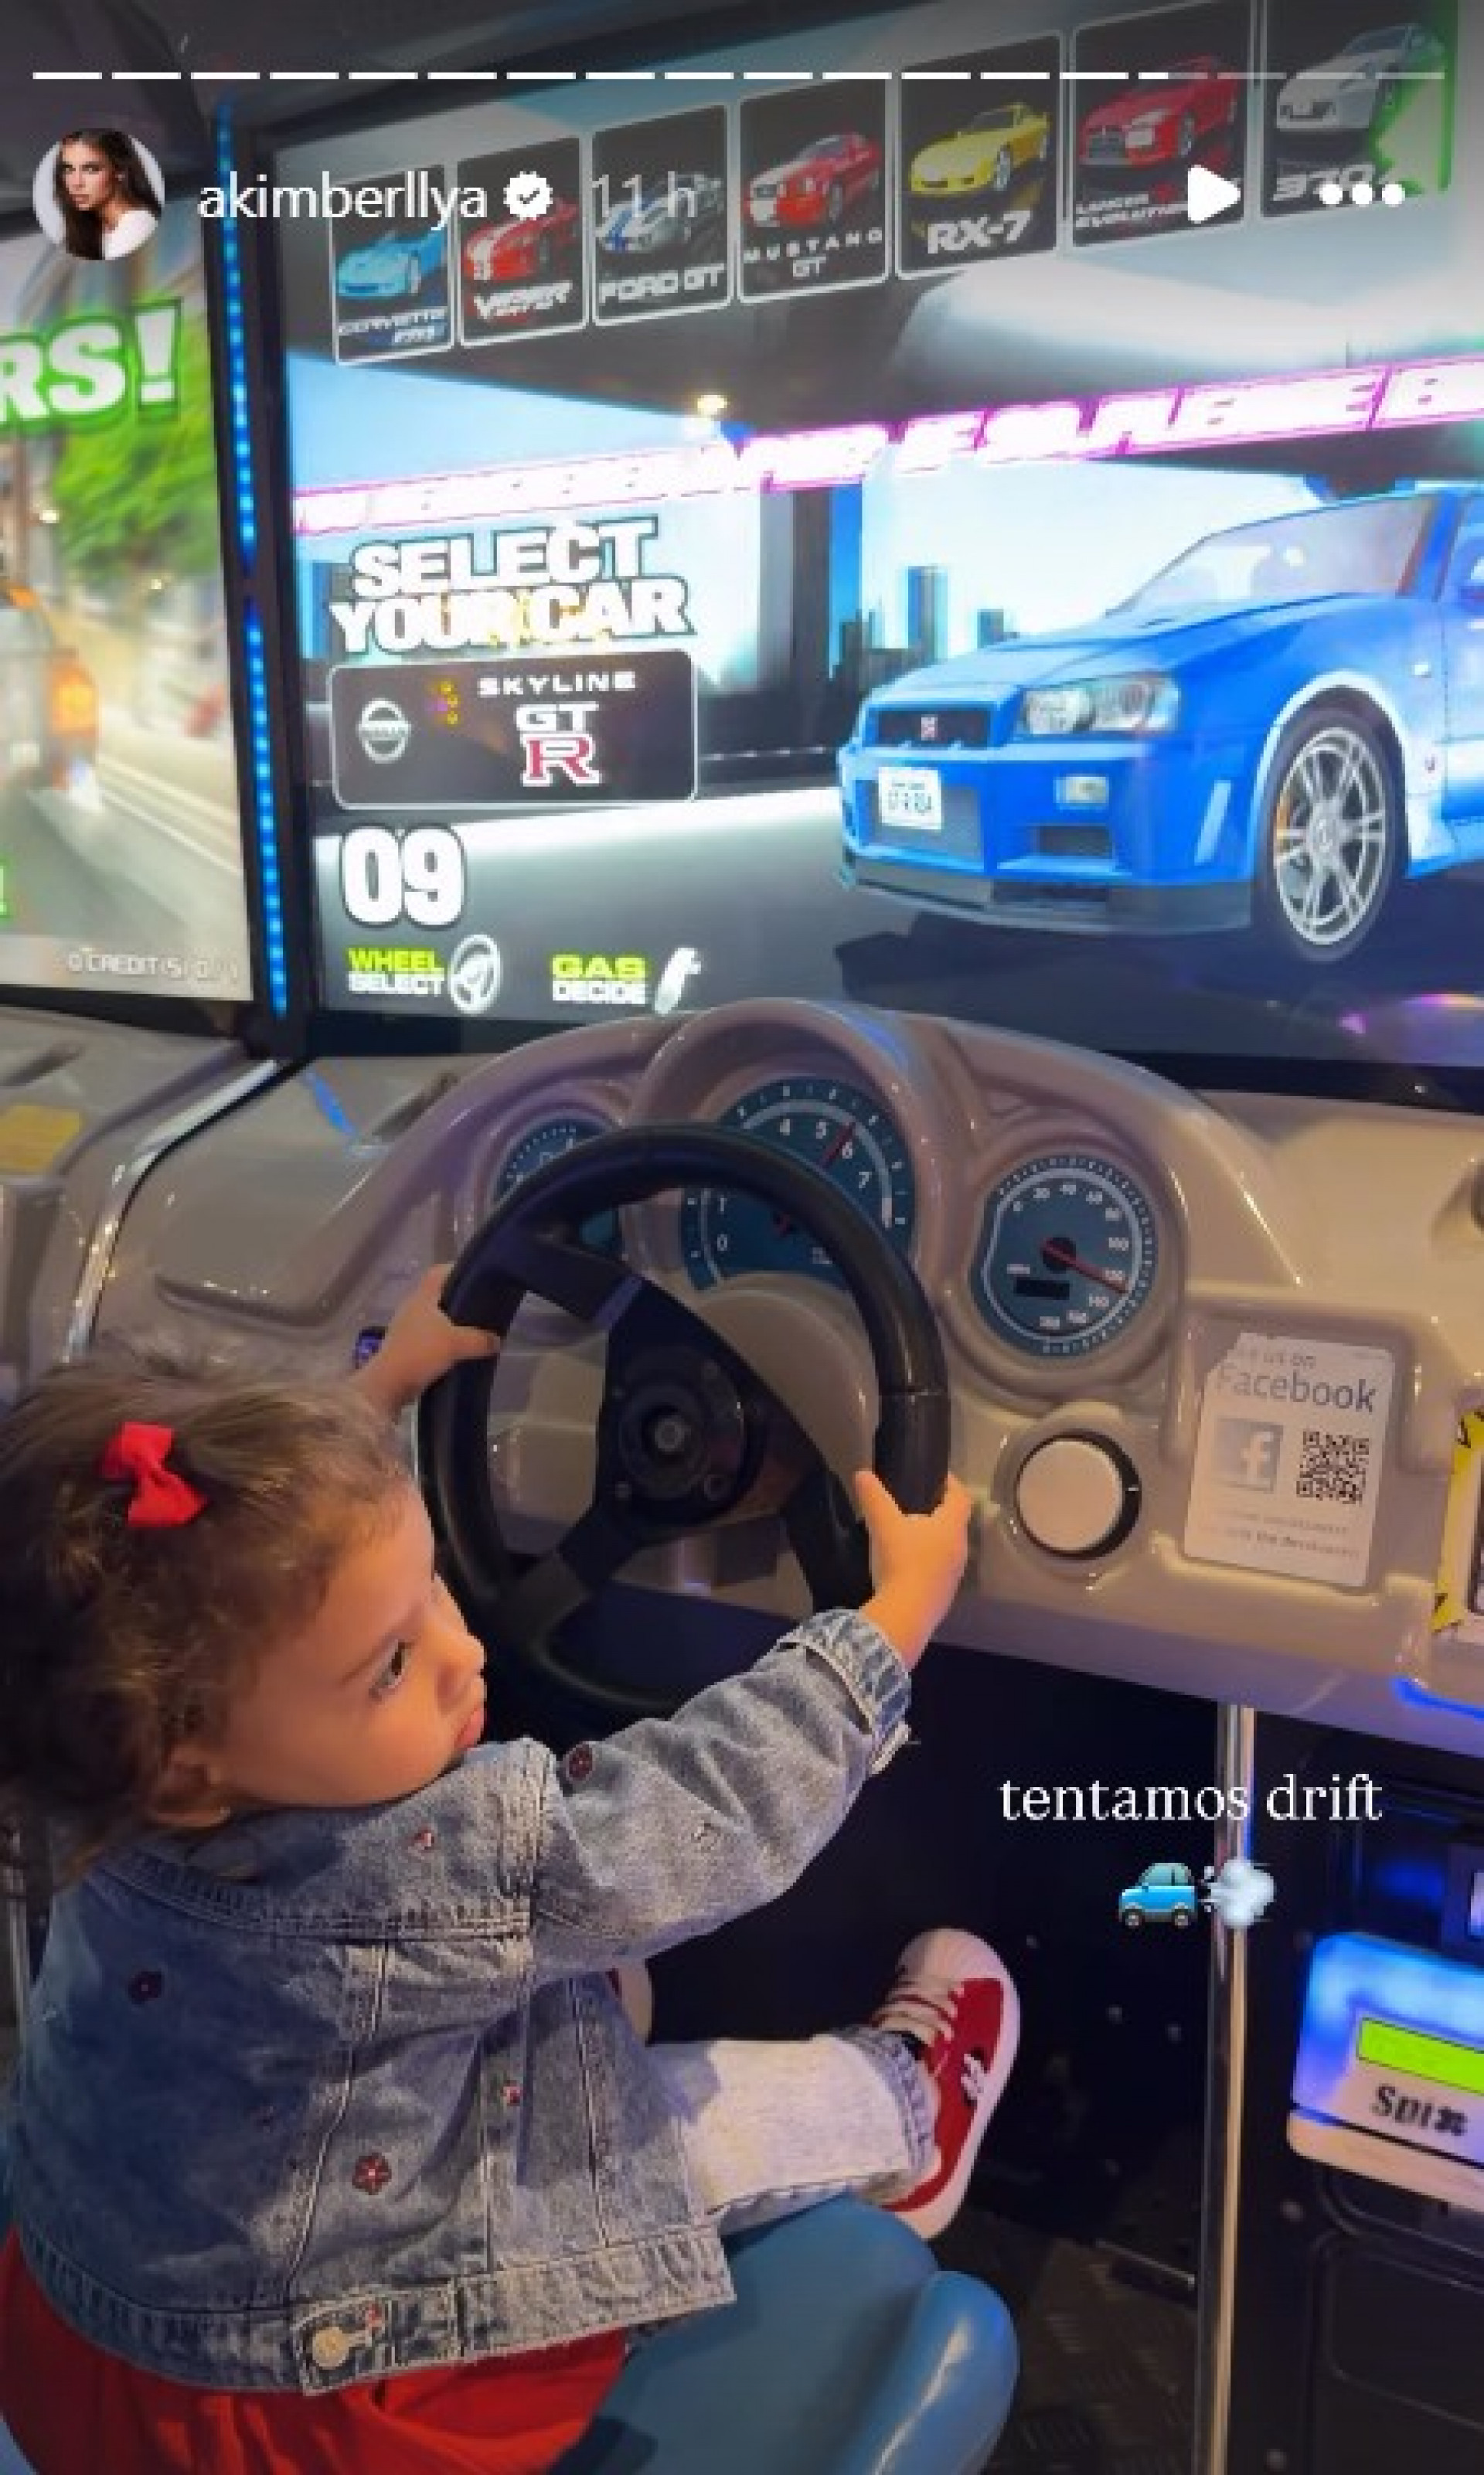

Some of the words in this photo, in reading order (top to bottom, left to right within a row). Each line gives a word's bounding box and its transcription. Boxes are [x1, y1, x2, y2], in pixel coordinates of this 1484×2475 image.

[744, 226, 883, 263] MUSTANG
[927, 209, 1033, 254] RX-7
[597, 270, 679, 305] FORD
[683, 262, 725, 291] GT
[791, 255, 825, 277] GT
[350, 515, 659, 598] SELECT
[329, 591, 527, 652] YOUR
[529, 577, 695, 646] CAR
[477, 670, 636, 698] SKYLINE
[515, 700, 599, 732] GT
[521, 734, 604, 787] R
[342, 825, 465, 929] 09
[346, 946, 441, 972] WHEEL
[550, 954, 648, 979] GAS
[346, 969, 445, 995] SELECT
[858, 1171, 872, 1190] 7
[1216, 1368, 1378, 1413] Facebook
